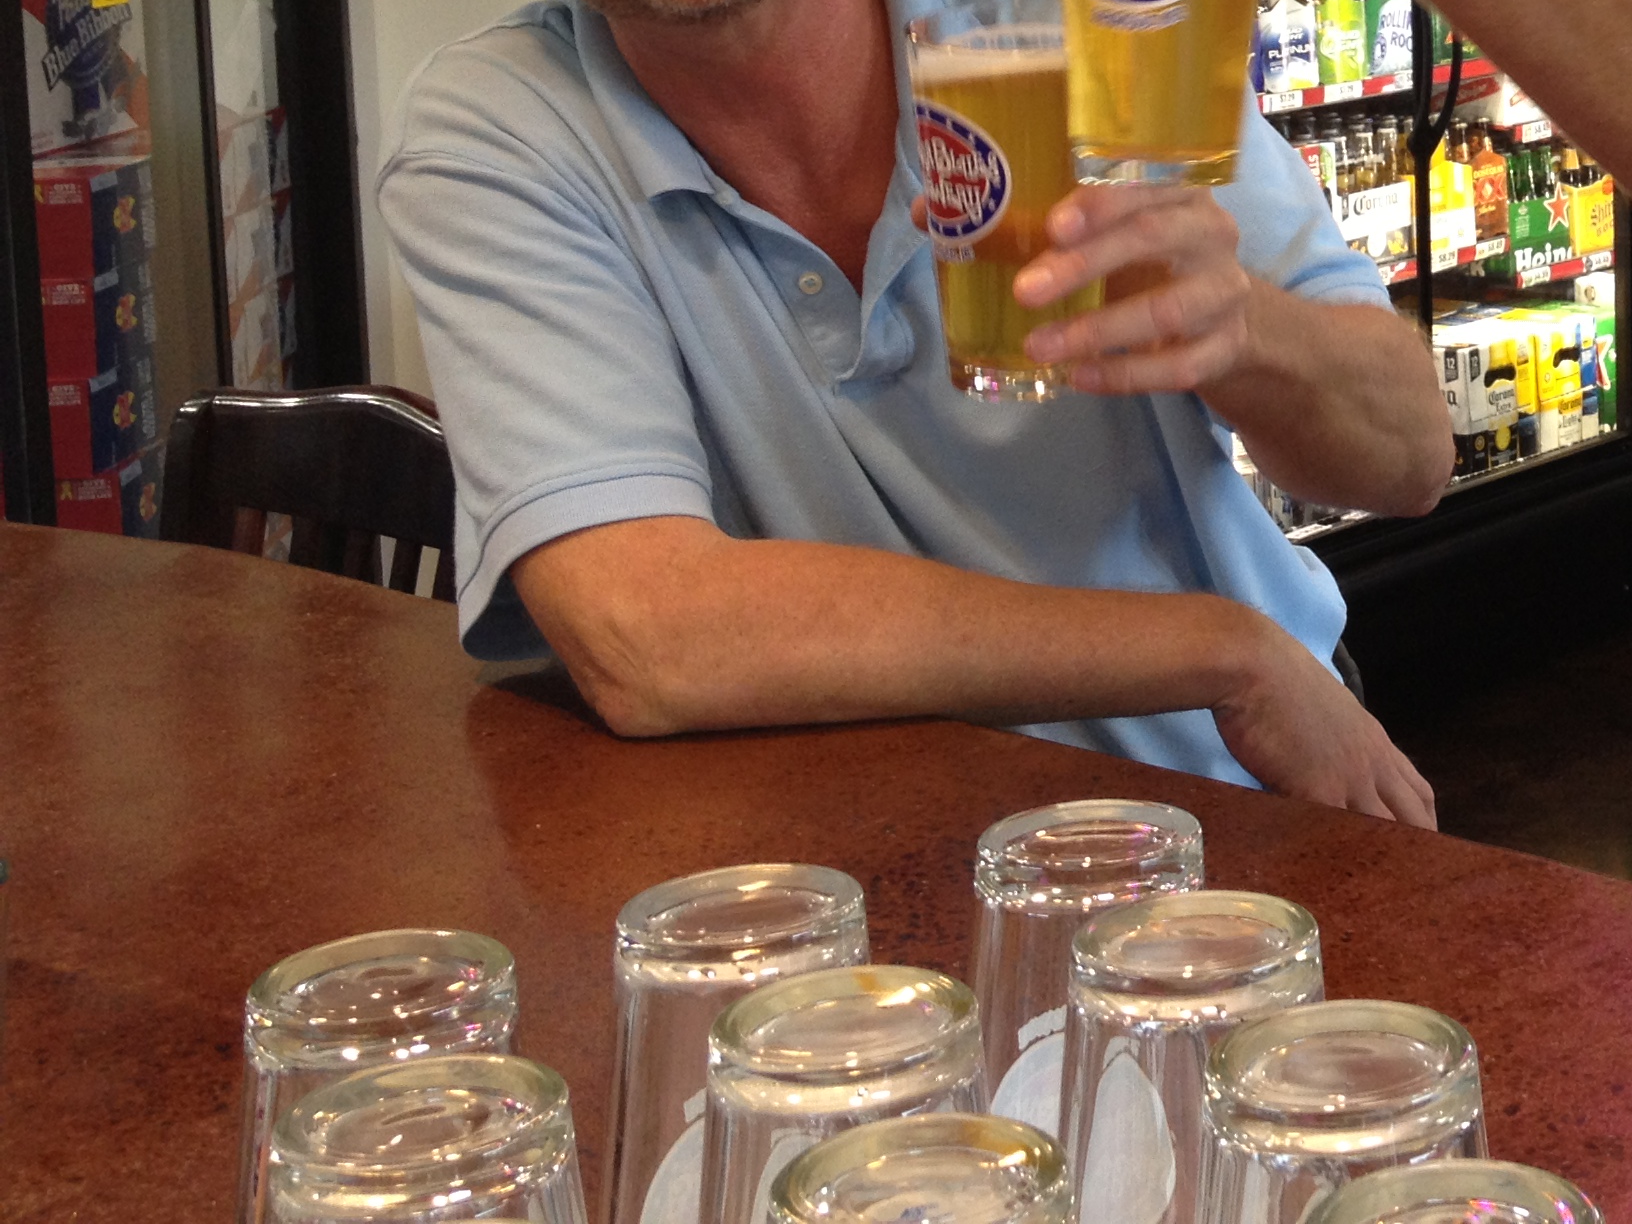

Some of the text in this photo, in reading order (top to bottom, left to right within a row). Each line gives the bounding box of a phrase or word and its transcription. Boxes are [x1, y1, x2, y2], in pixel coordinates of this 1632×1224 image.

[1381, 9, 1413, 29] ROLLIN
[44, 5, 131, 82] Blue Ribbon
[1390, 31, 1413, 52] ROC
[1353, 193, 1399, 216] Corna
[1514, 242, 1572, 271] Hein
[1446, 357, 1455, 370] 12
[1488, 387, 1515, 406] Corona
